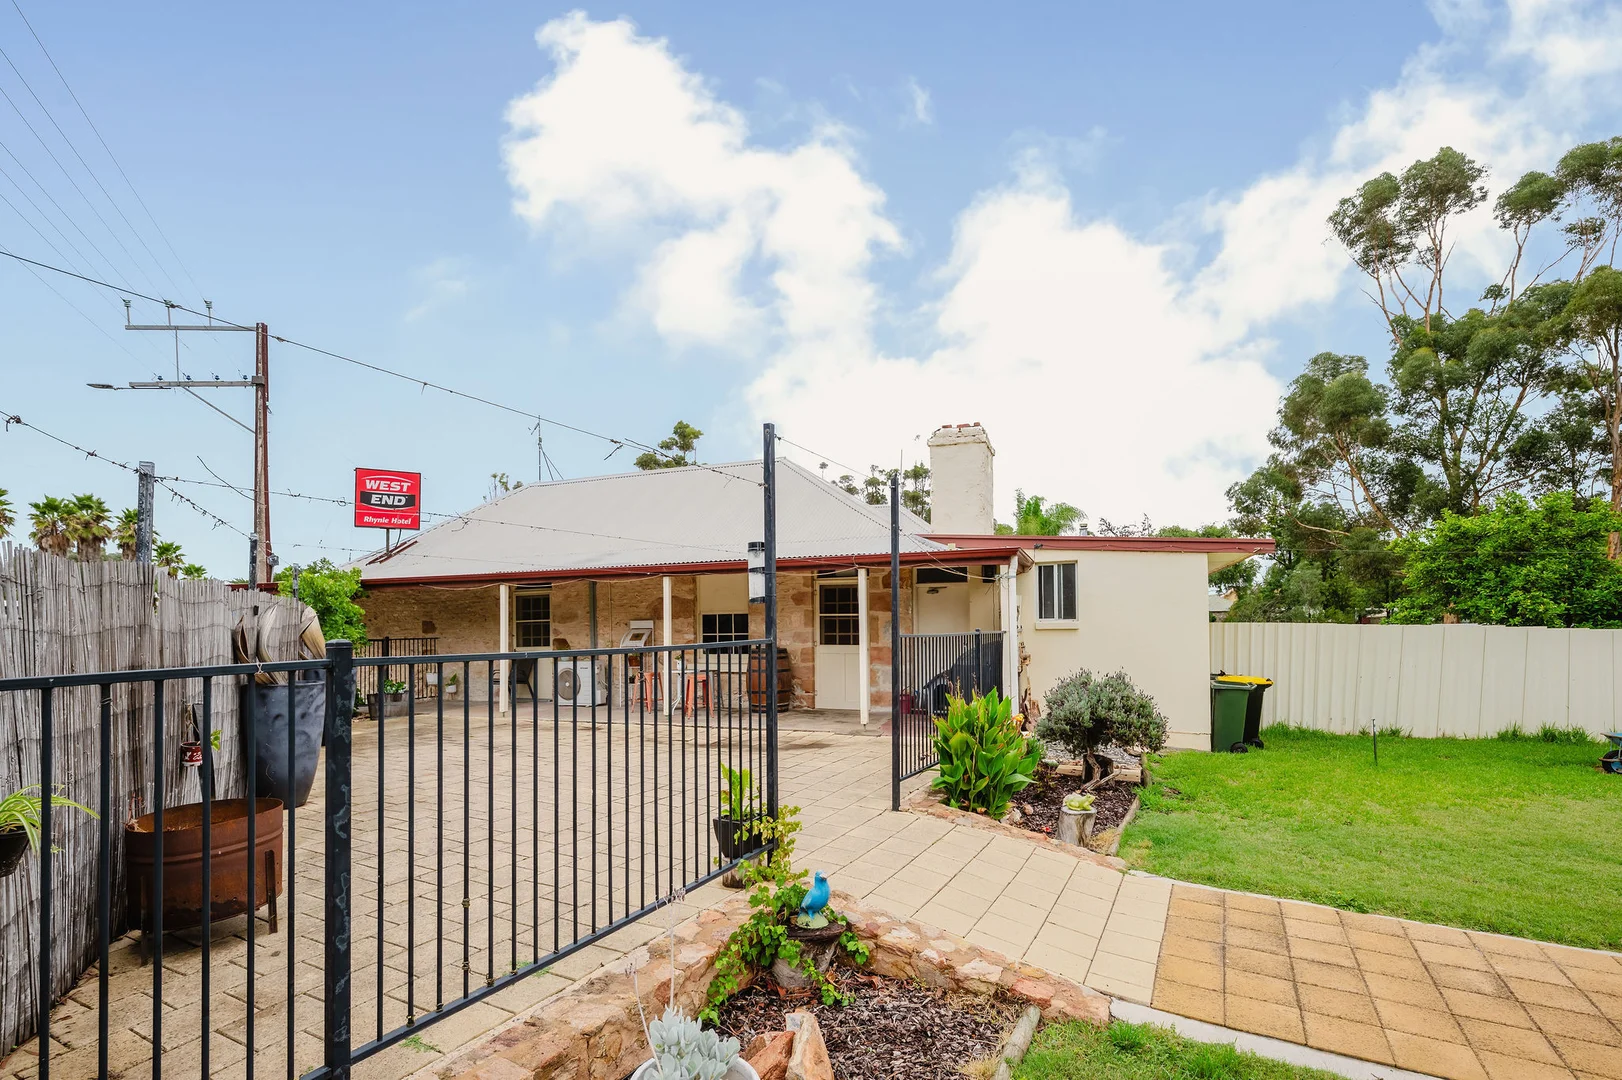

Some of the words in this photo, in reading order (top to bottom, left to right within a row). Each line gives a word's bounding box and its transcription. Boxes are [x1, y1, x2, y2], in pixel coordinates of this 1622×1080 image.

[365, 479, 411, 492] WEST
[370, 494, 406, 506] END
[363, 516, 390, 524] Rhynie
[391, 517, 412, 525] Hotel
